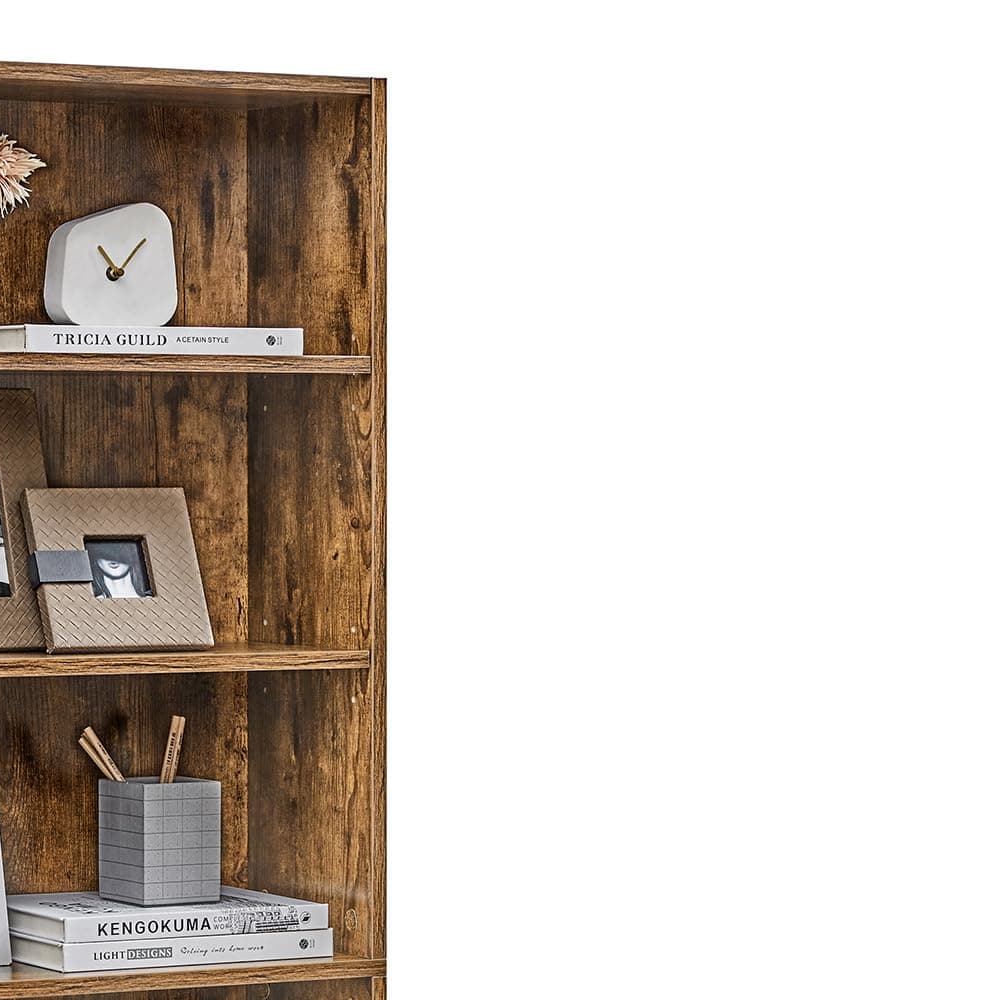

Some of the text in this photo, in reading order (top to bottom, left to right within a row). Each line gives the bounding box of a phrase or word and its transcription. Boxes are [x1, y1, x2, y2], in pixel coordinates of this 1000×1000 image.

[53, 333, 168, 346] TRICIA GUILD
[98, 917, 211, 936] KENGOKUMA
[94, 947, 172, 960] LIGHT DESIGNS
